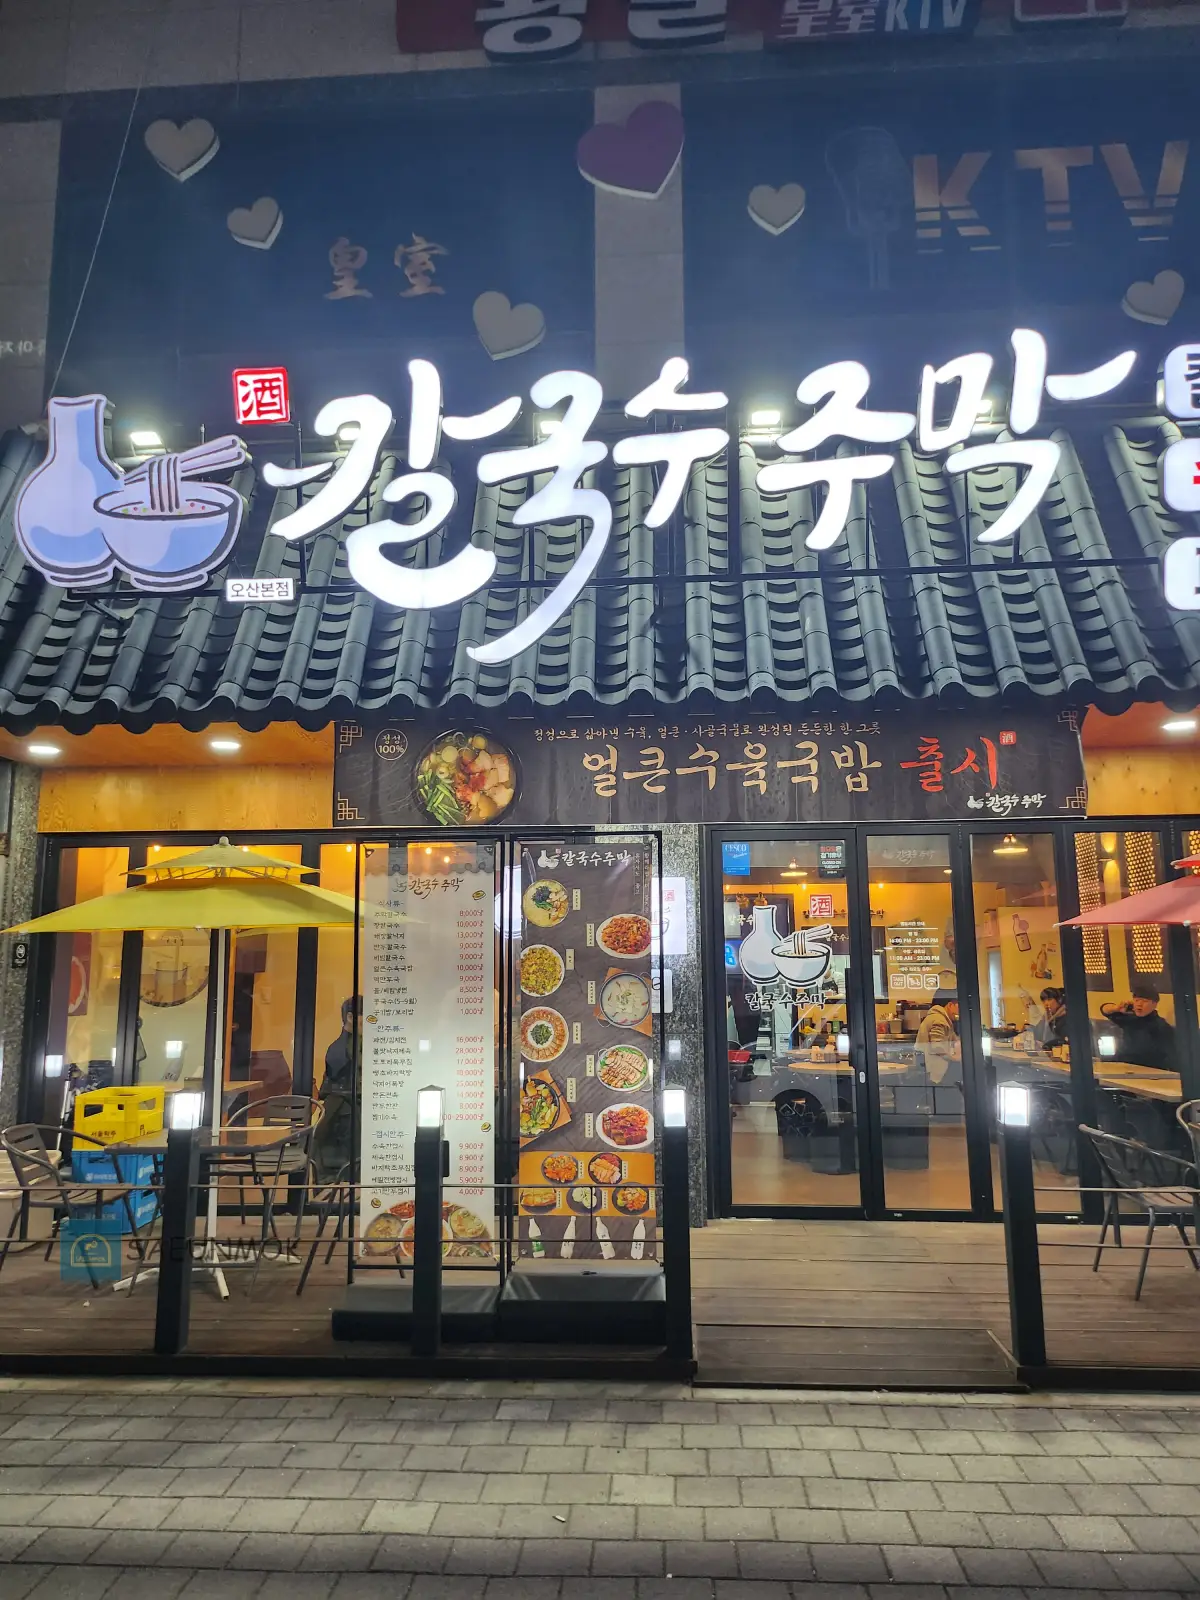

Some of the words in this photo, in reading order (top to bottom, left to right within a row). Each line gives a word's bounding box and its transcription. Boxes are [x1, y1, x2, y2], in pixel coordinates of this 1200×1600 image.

[913, 140, 1189, 254] KTV
[238, 375, 285, 419] 酒
[756, 328, 1138, 551] 주막
[230, 582, 290, 598] 오산본점
[534, 728, 580, 741] 정성으로
[584, 727, 620, 740] 삶아낸
[658, 726, 680, 738] 얼큰
[691, 724, 753, 738] 사골국물로
[758, 724, 793, 737] 완성된
[798, 722, 836, 736] 든든한
[840, 722, 853, 735] 한
[856, 721, 881, 735] 그릇
[378, 745, 405, 755] 100%
[900, 736, 997, 793] 출시
[812, 897, 832, 916] 酒
[745, 992, 828, 1011] 칼국수주막
